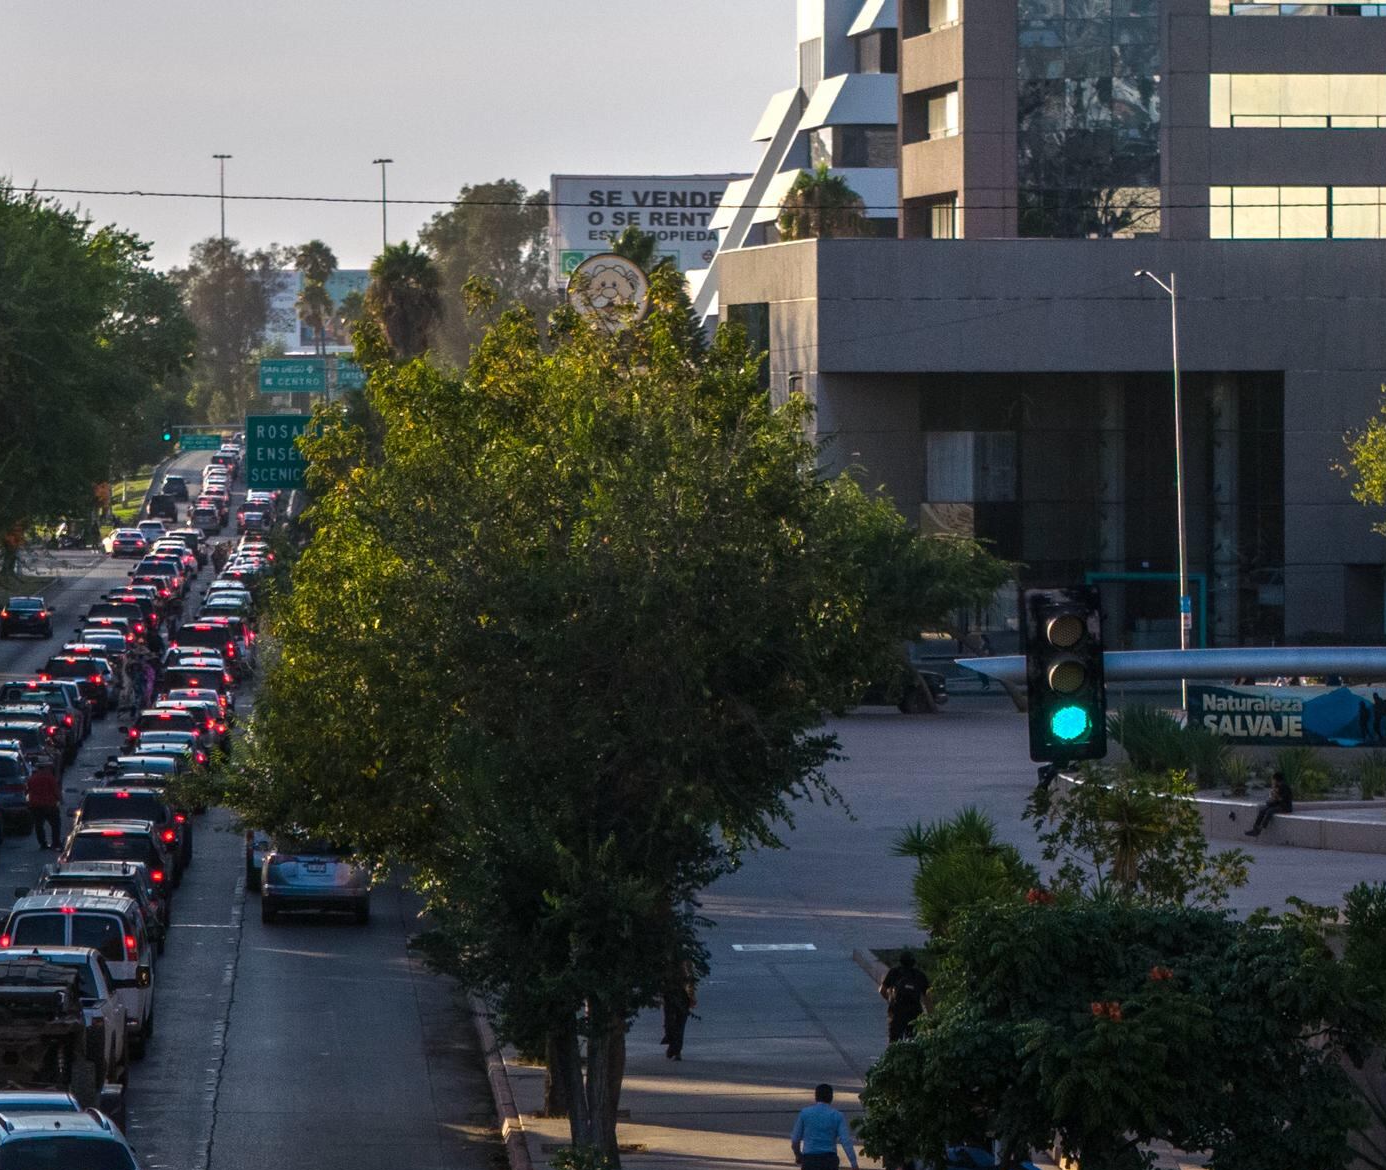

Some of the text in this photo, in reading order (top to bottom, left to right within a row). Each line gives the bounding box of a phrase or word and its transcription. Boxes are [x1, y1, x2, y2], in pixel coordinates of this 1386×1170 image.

[588, 190, 724, 208] SE VENDE
[588, 211, 604, 226] O
[611, 211, 641, 226] SE
[277, 377, 320, 387] CENTRO
[1203, 693, 1303, 712] Naturaleza
[1203, 715, 1303, 737] SALVAJE
